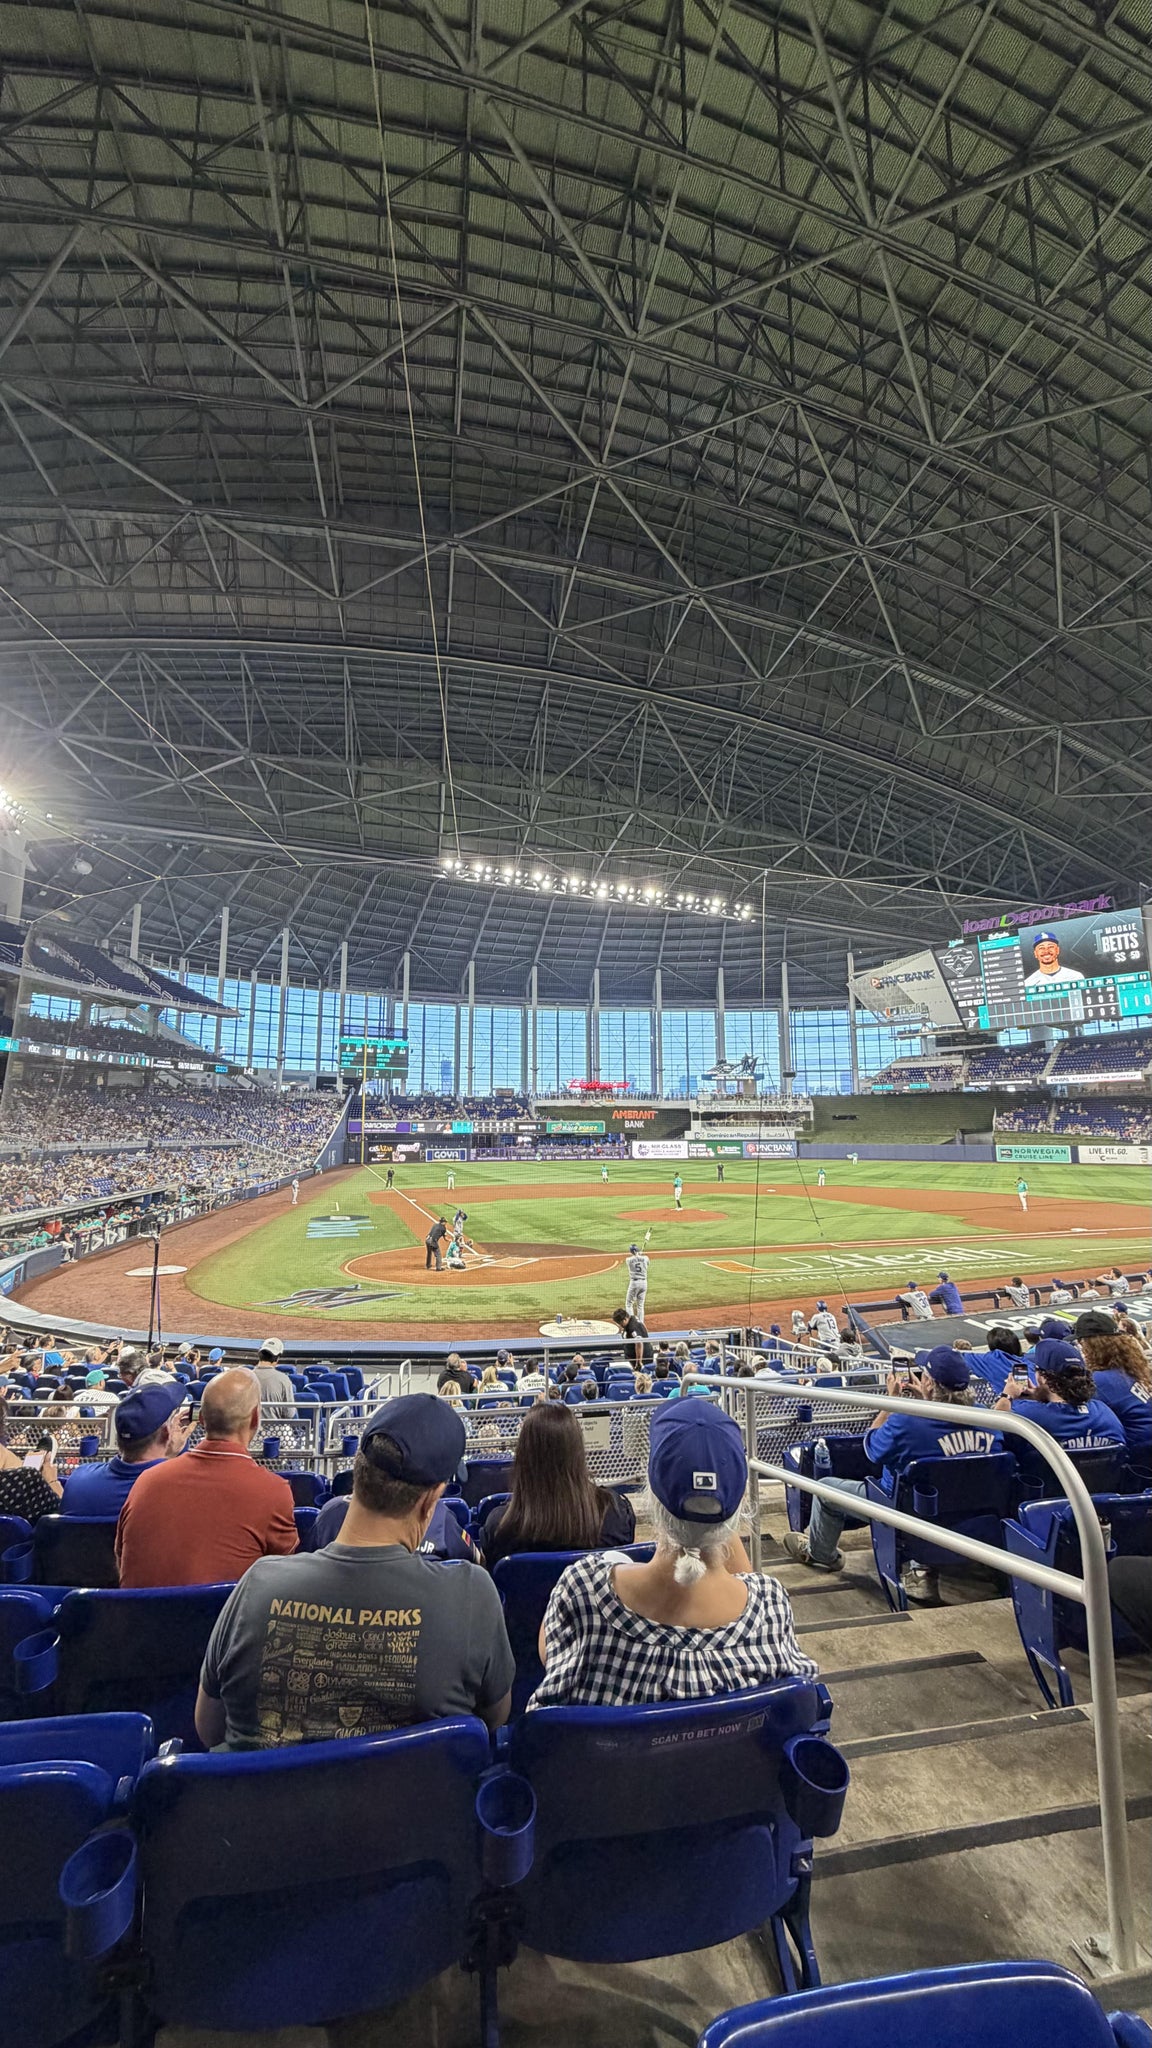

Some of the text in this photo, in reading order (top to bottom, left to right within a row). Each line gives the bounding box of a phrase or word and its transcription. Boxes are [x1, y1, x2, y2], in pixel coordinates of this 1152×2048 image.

[962, 894, 1113, 934] loanDepot park
[1105, 922, 1137, 935] MOOKIE
[1101, 931, 1139, 952] BETTS
[1114, 951, 1127, 963] SS
[624, 1120, 645, 1129] BANK
[634, 1262, 642, 1273] 5
[826, 1318, 836, 1330] 13
[937, 1430, 995, 1457] MUNCY
[269, 1598, 422, 1627] NATIONAL PARKS
[323, 1628, 362, 1642] Joshua
[293, 1655, 334, 1670] Everglades
[384, 1654, 413, 1664] SEQUOIA
[651, 1723, 742, 1746] SCAN TO BET NOW
